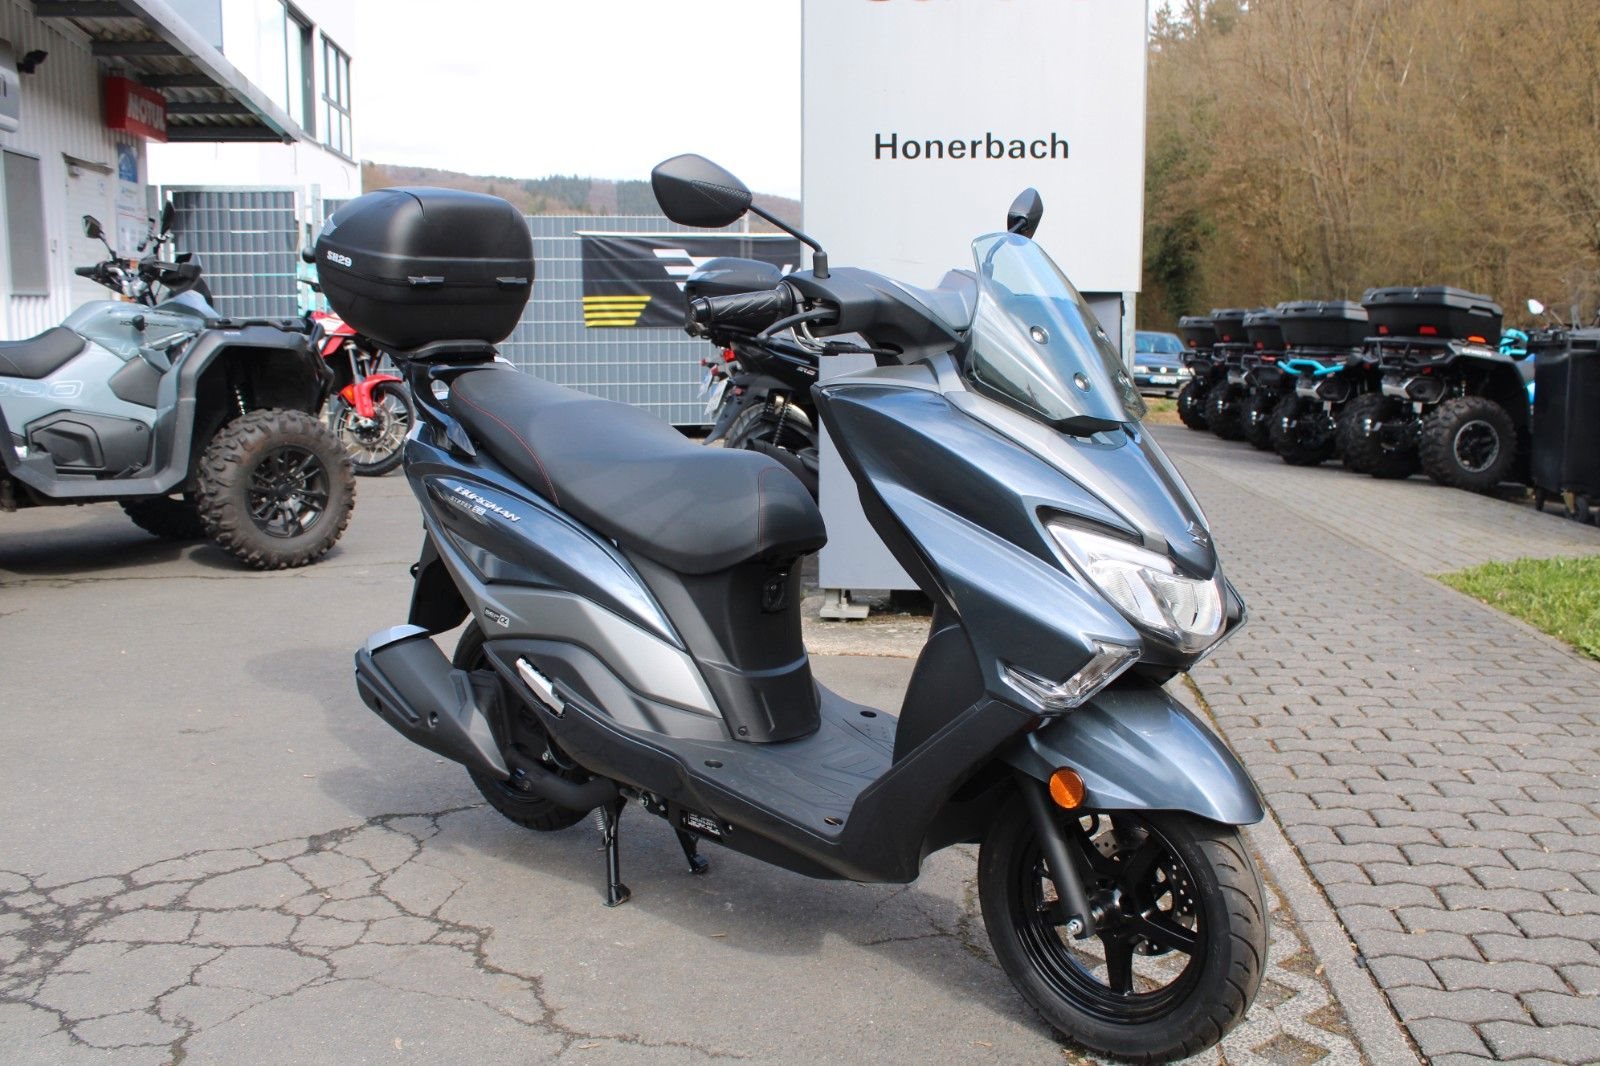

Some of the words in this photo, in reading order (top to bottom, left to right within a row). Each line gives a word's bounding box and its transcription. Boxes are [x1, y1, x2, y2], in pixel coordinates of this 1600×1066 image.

[128, 92, 166, 132] MOTUL
[875, 132, 1069, 159] Honerbach
[327, 250, 352, 267] SH29
[455, 486, 521, 521] BURGMAN
